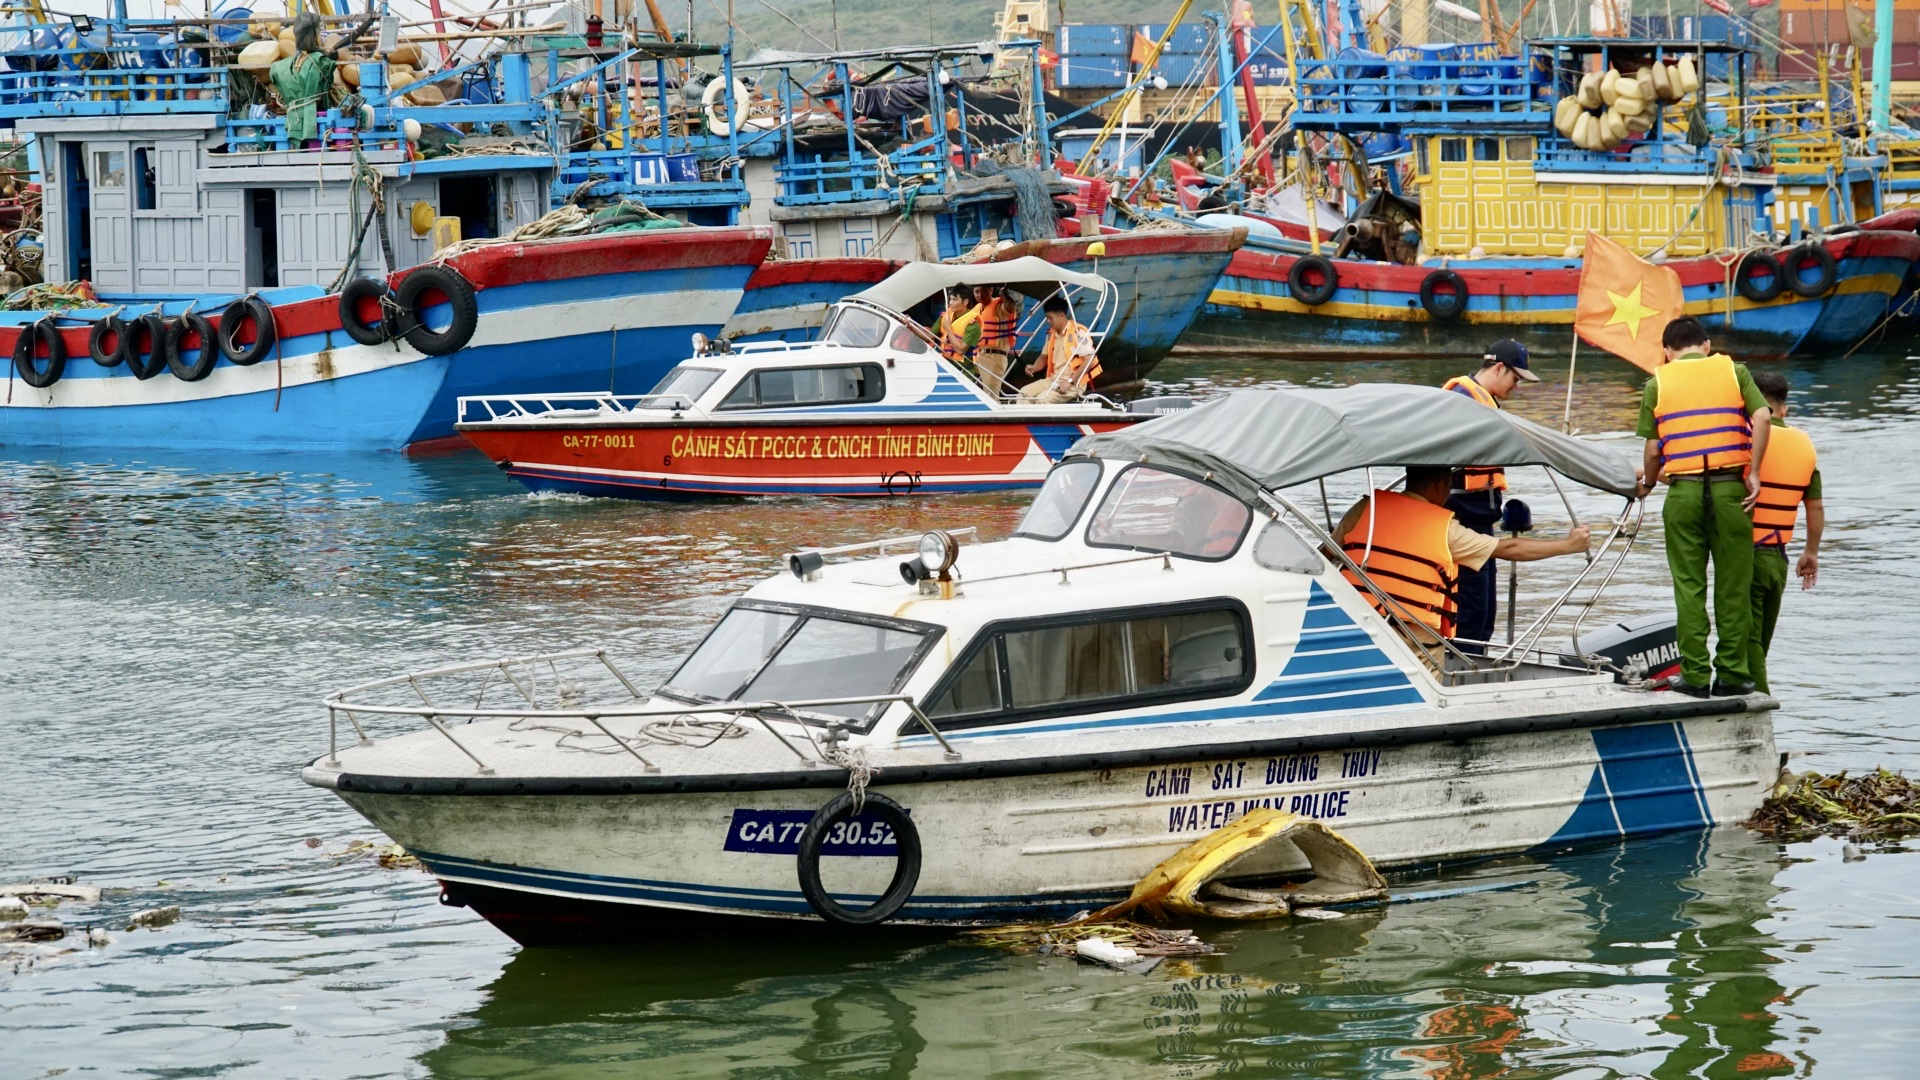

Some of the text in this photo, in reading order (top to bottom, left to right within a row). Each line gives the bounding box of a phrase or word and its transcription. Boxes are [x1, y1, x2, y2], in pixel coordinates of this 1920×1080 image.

[966, 113, 1001, 126] OTA
[563, 434, 635, 448] CA-77-0011
[671, 428, 994, 461] CẢNH SÁT PCCC & CNCH TỈNH BÌNH ĐỊNH
[663, 455, 672, 467] 6
[660, 477, 667, 489] 4
[1626, 640, 1685, 669] YAMAH
[1168, 801, 1236, 833] WATER
[1290, 790, 1351, 819] POLICE
